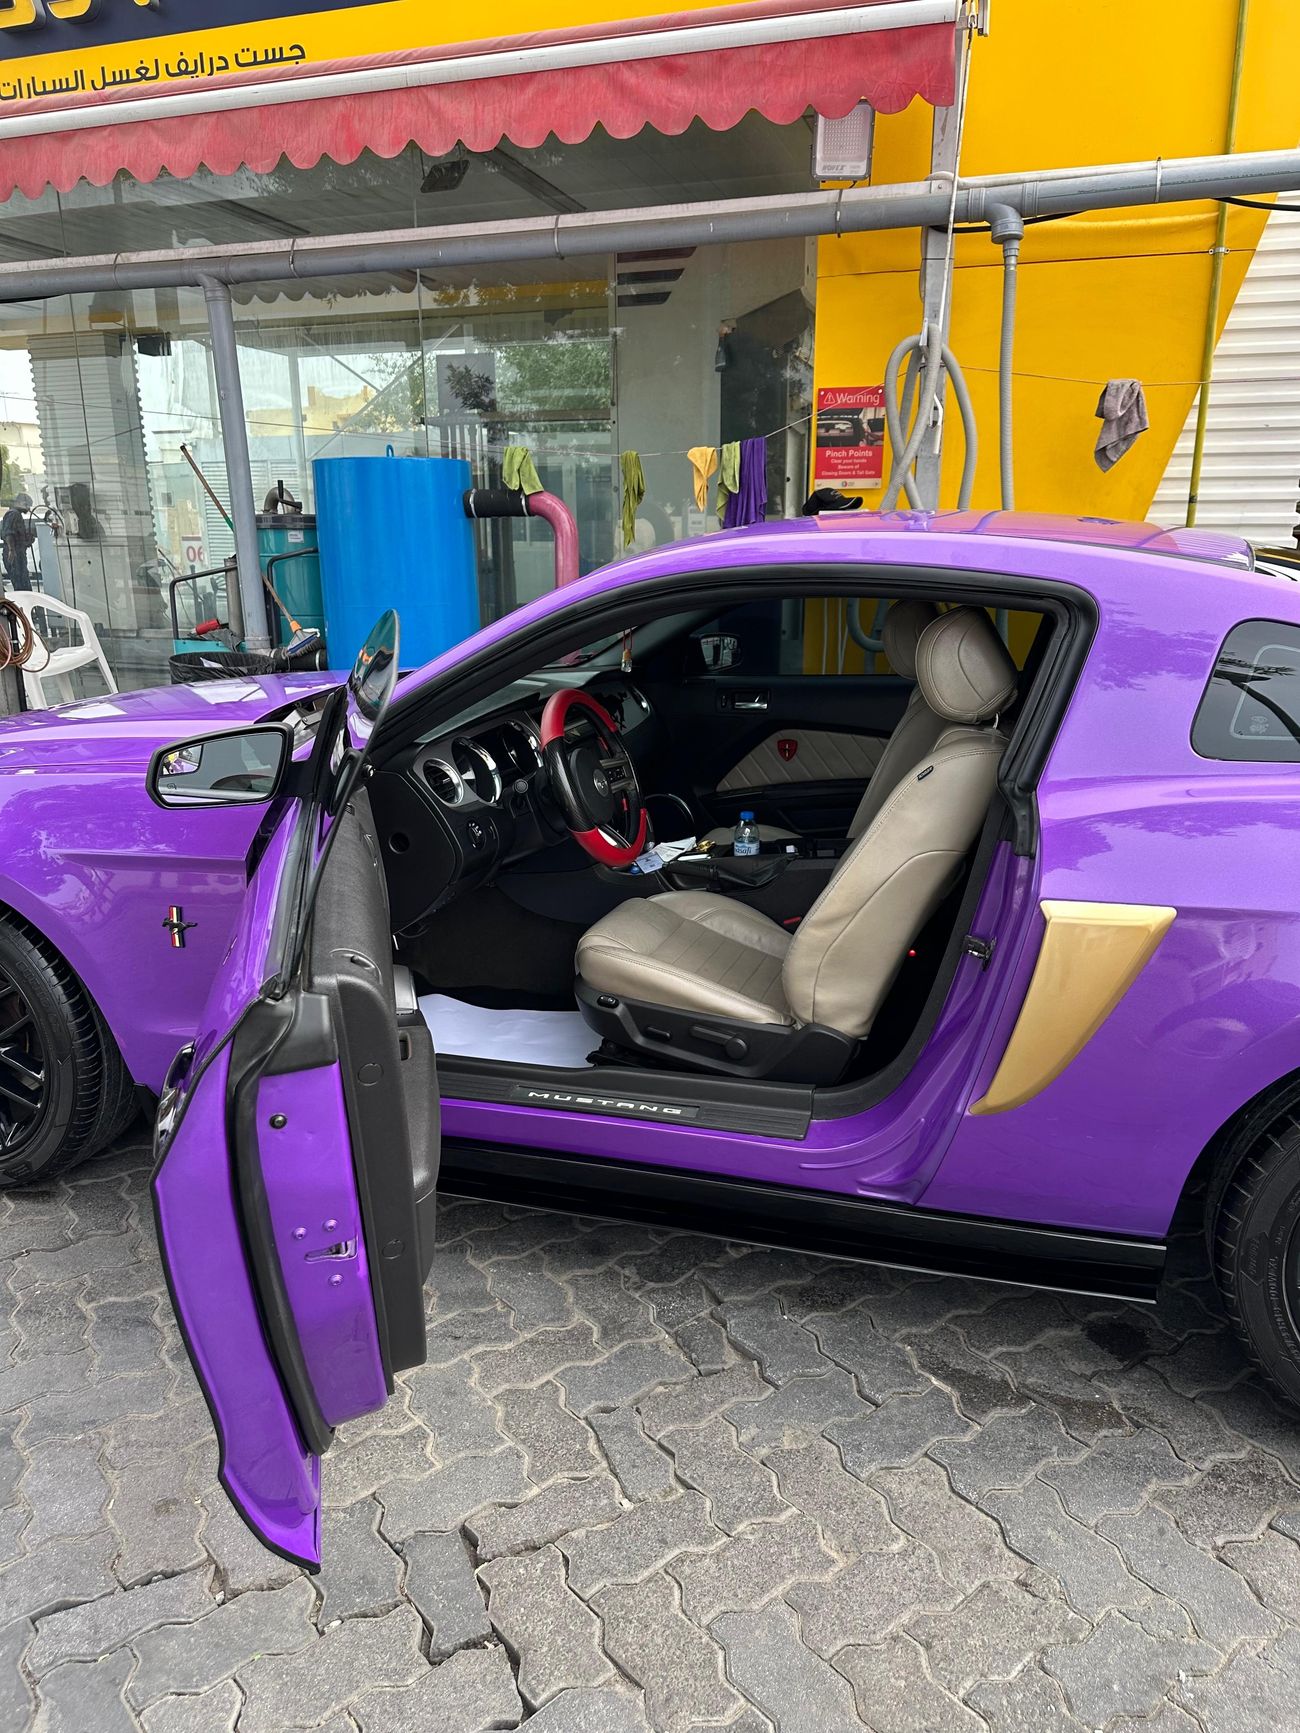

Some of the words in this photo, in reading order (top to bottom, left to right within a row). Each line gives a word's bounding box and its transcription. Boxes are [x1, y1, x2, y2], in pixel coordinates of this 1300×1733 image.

[165, 52, 229, 79] درايف
[234, 43, 306, 67] جست
[90, 58, 159, 91] لغسل
[836, 393, 880, 406] Warning
[825, 449, 847, 457] Pinch
[848, 449, 873, 457] Points
[528, 1091, 682, 1115] MUSTANG
